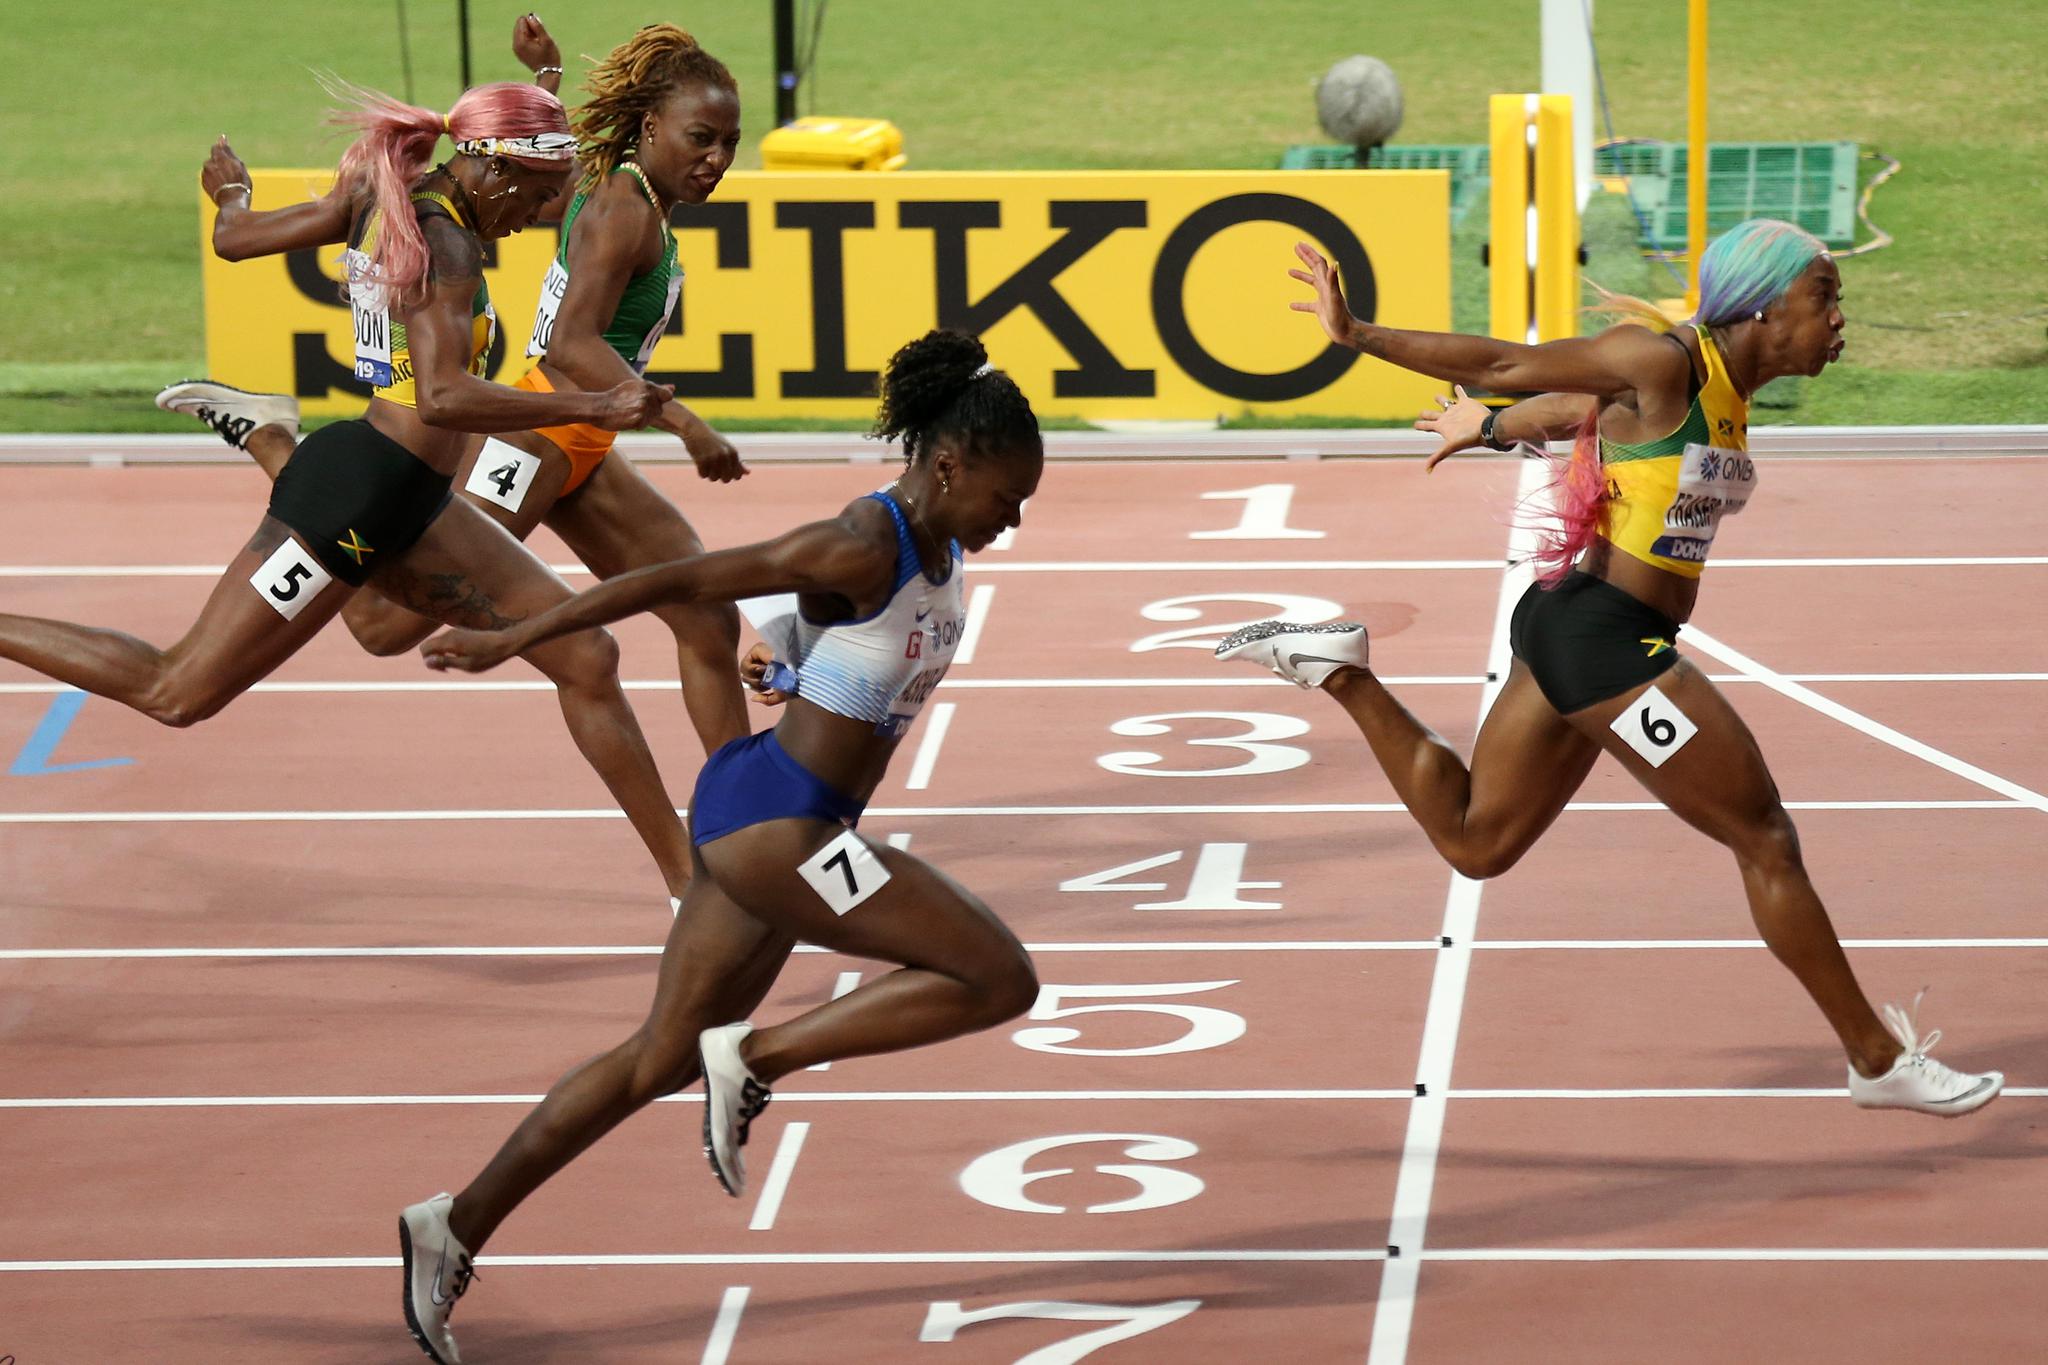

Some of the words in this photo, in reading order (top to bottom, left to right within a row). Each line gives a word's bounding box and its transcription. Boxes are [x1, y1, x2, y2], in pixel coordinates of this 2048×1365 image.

[487, 459, 522, 498] 4
[1187, 483, 1328, 540] 1
[269, 561, 313, 603] 5
[1128, 592, 1346, 654] 2
[1096, 711, 1312, 778] 3
[1640, 705, 1677, 748] 6
[820, 847, 860, 898] 7
[1058, 842, 1284, 911] 4
[1011, 979, 1248, 1057] 5
[958, 1132, 1206, 1215] 6
[918, 1299, 1204, 1365] 7
